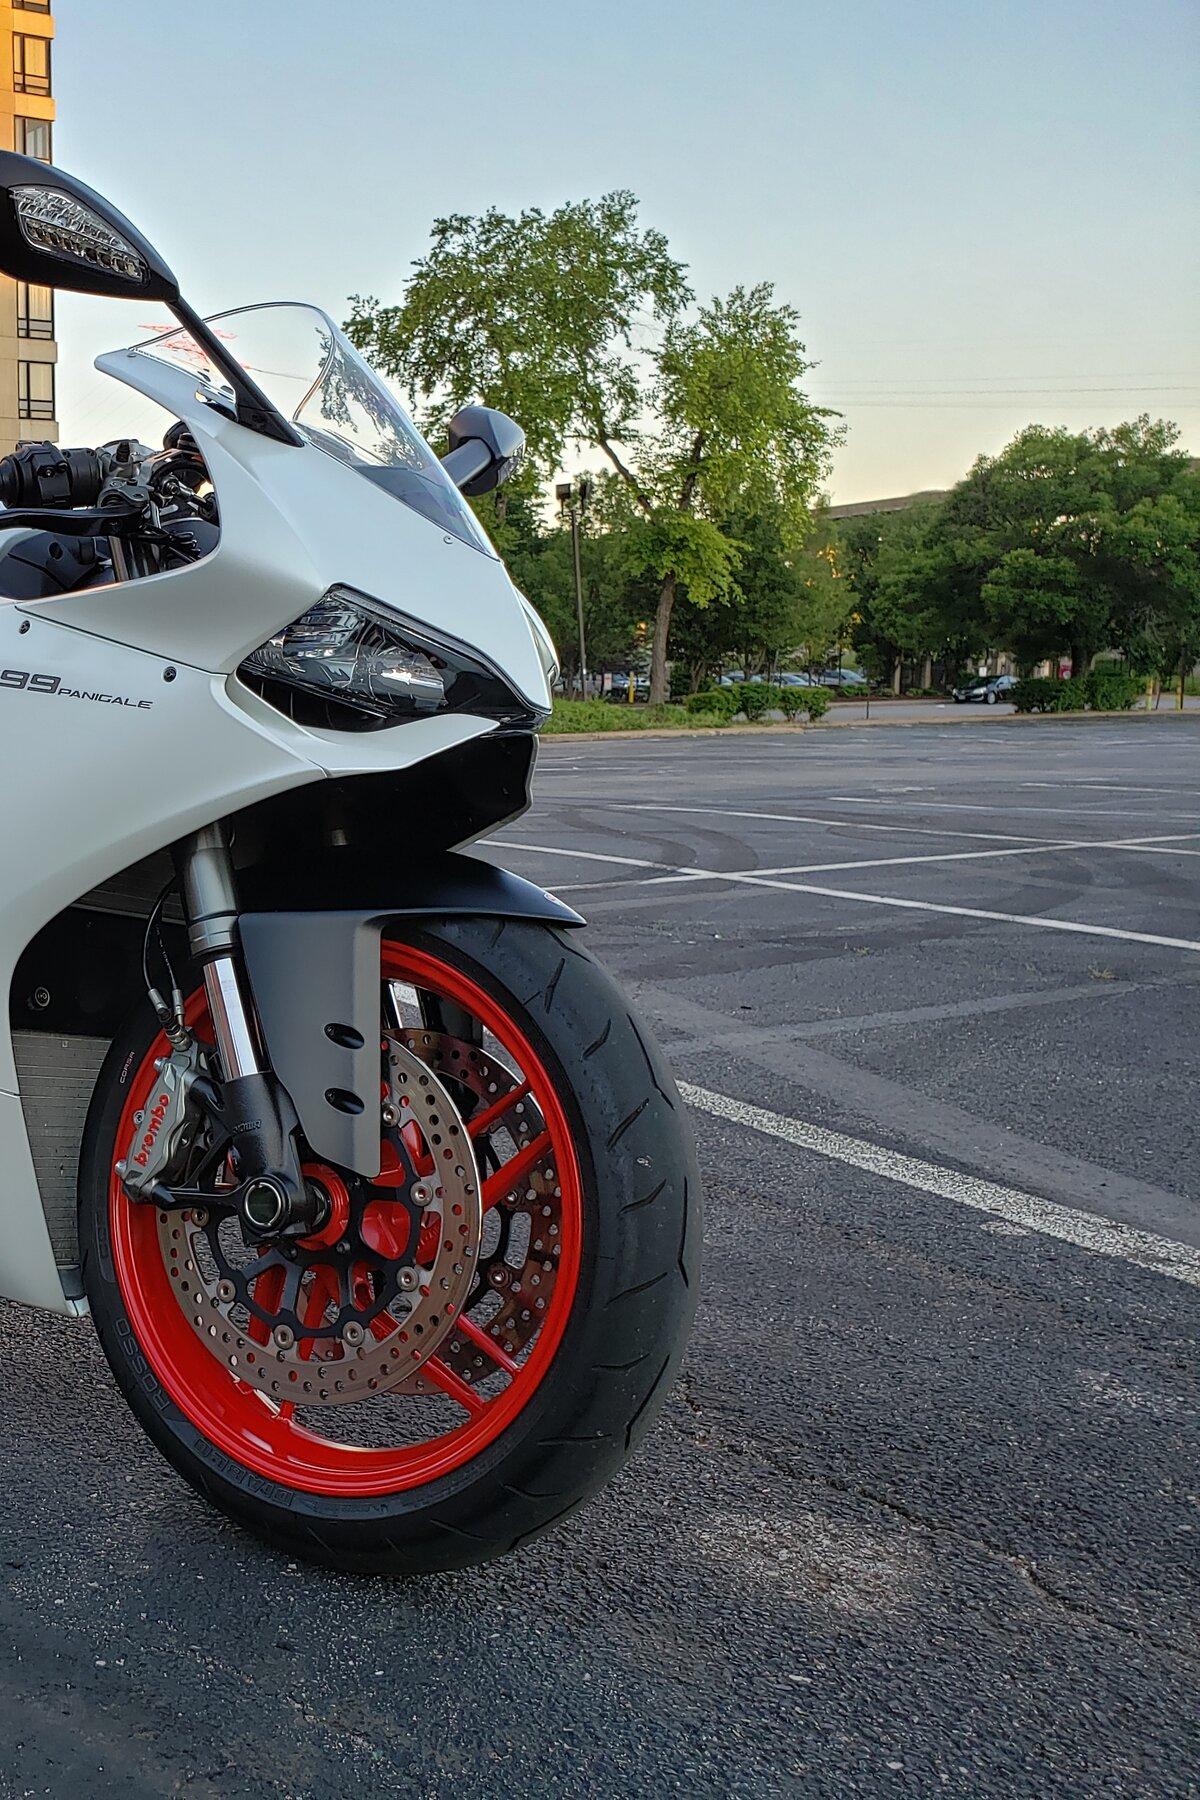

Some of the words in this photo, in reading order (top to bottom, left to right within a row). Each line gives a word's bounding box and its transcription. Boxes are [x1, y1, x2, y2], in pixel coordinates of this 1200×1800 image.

[57, 688, 153, 710] PANIGALE
[119, 1051, 135, 1084] CORSA
[133, 1093, 171, 1168] brembo
[115, 1317, 171, 1412] ROSSO
